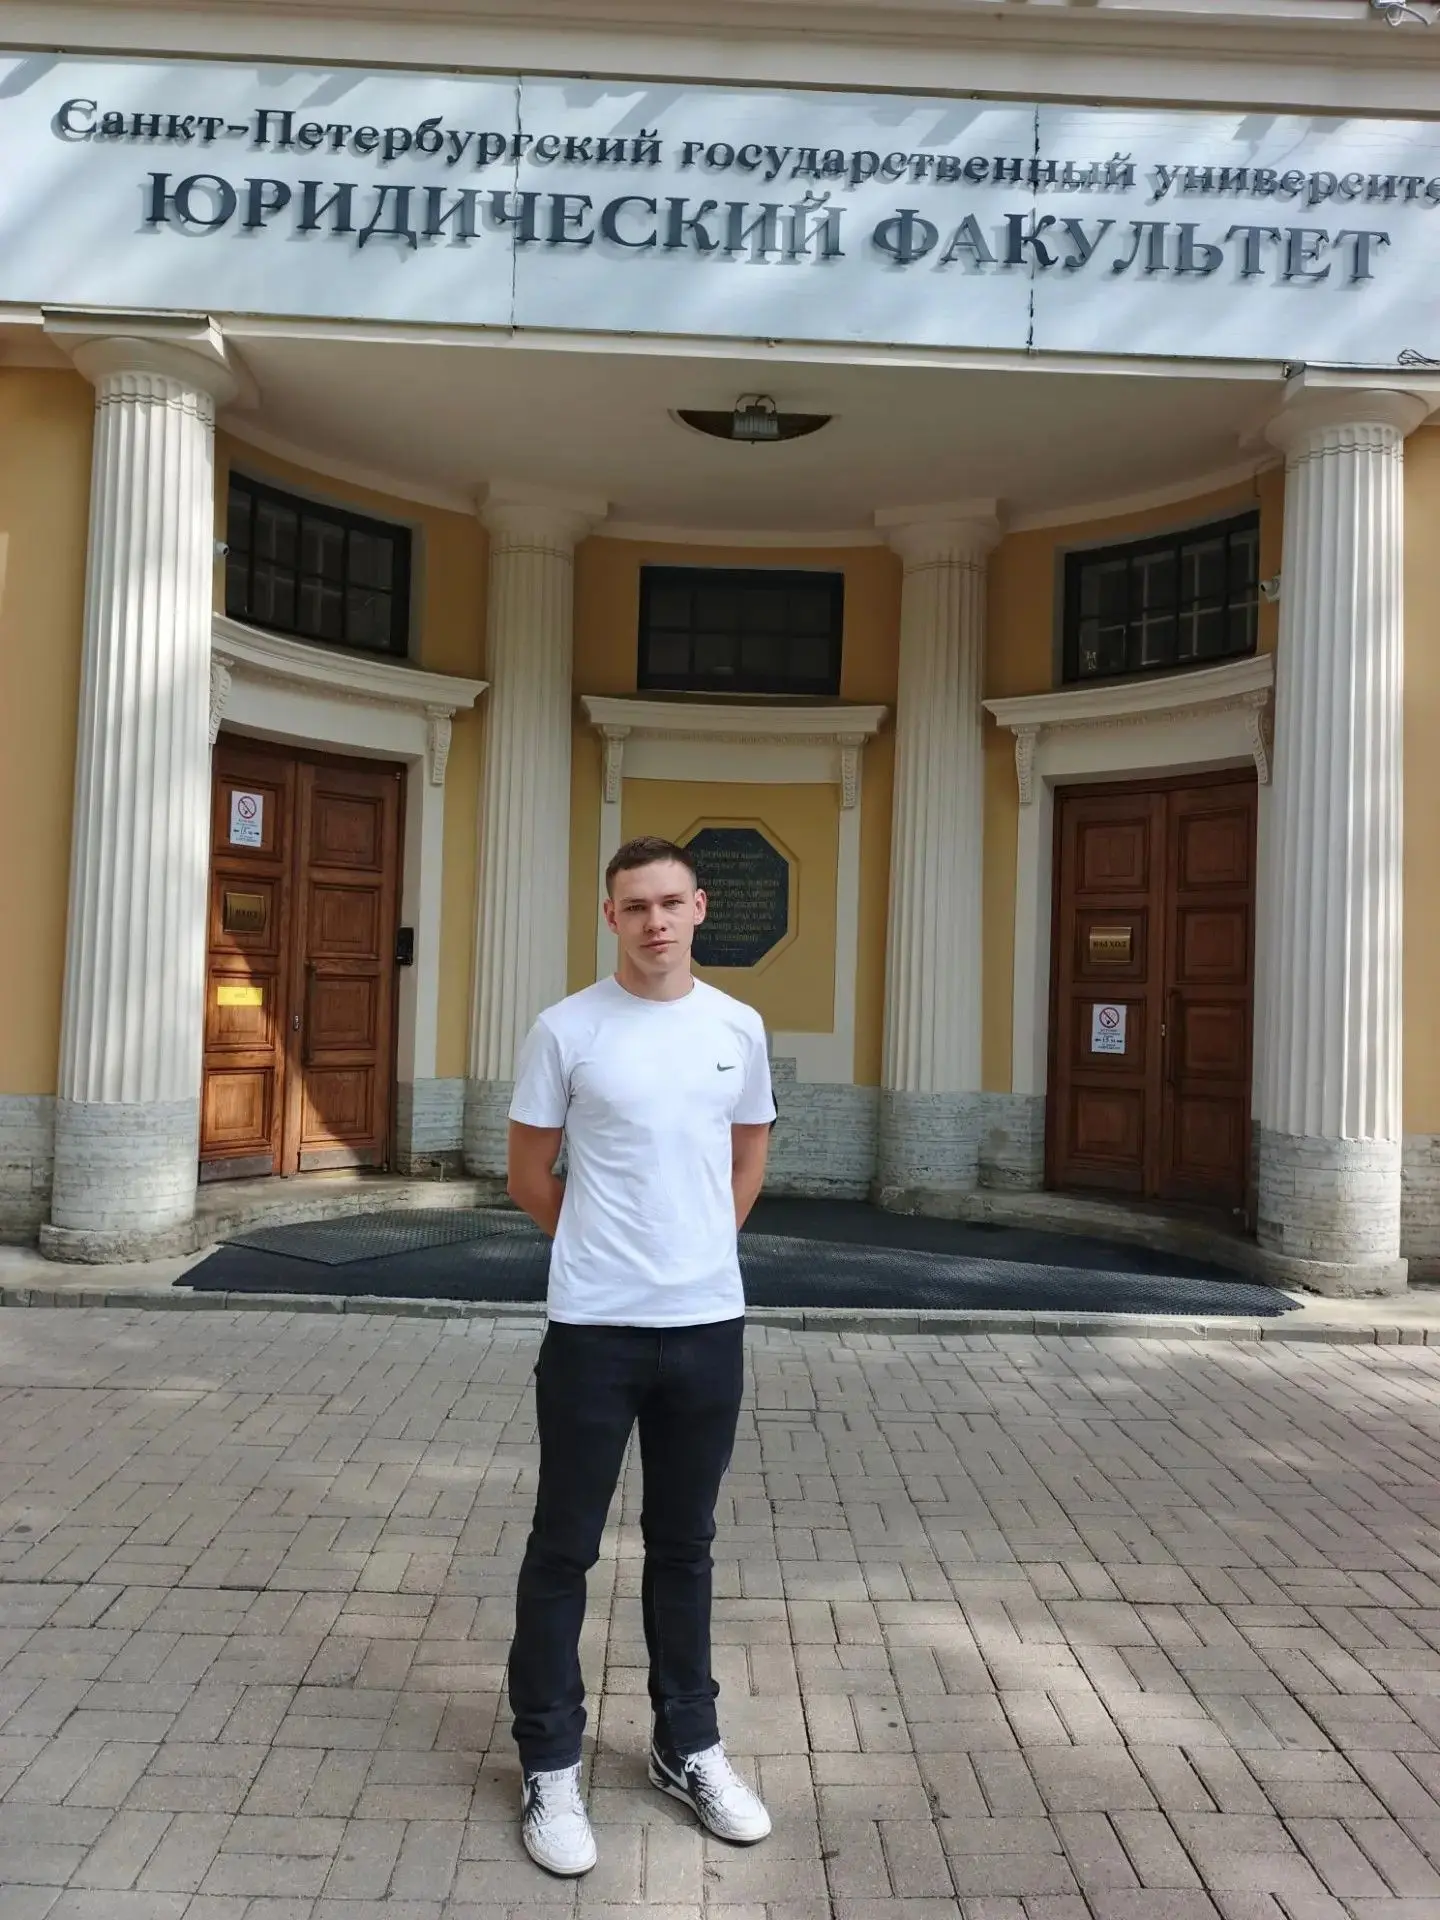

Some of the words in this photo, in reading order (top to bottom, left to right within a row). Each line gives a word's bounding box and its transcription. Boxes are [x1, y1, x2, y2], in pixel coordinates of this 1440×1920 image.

[58, 98, 662, 165] Санкт-Петербургский
[682, 140, 1137, 187] государственный
[145, 171, 846, 257] ЮРИДИЧЕСКИЙ
[872, 208, 1391, 280] ФАКУЛЬТЕТ
